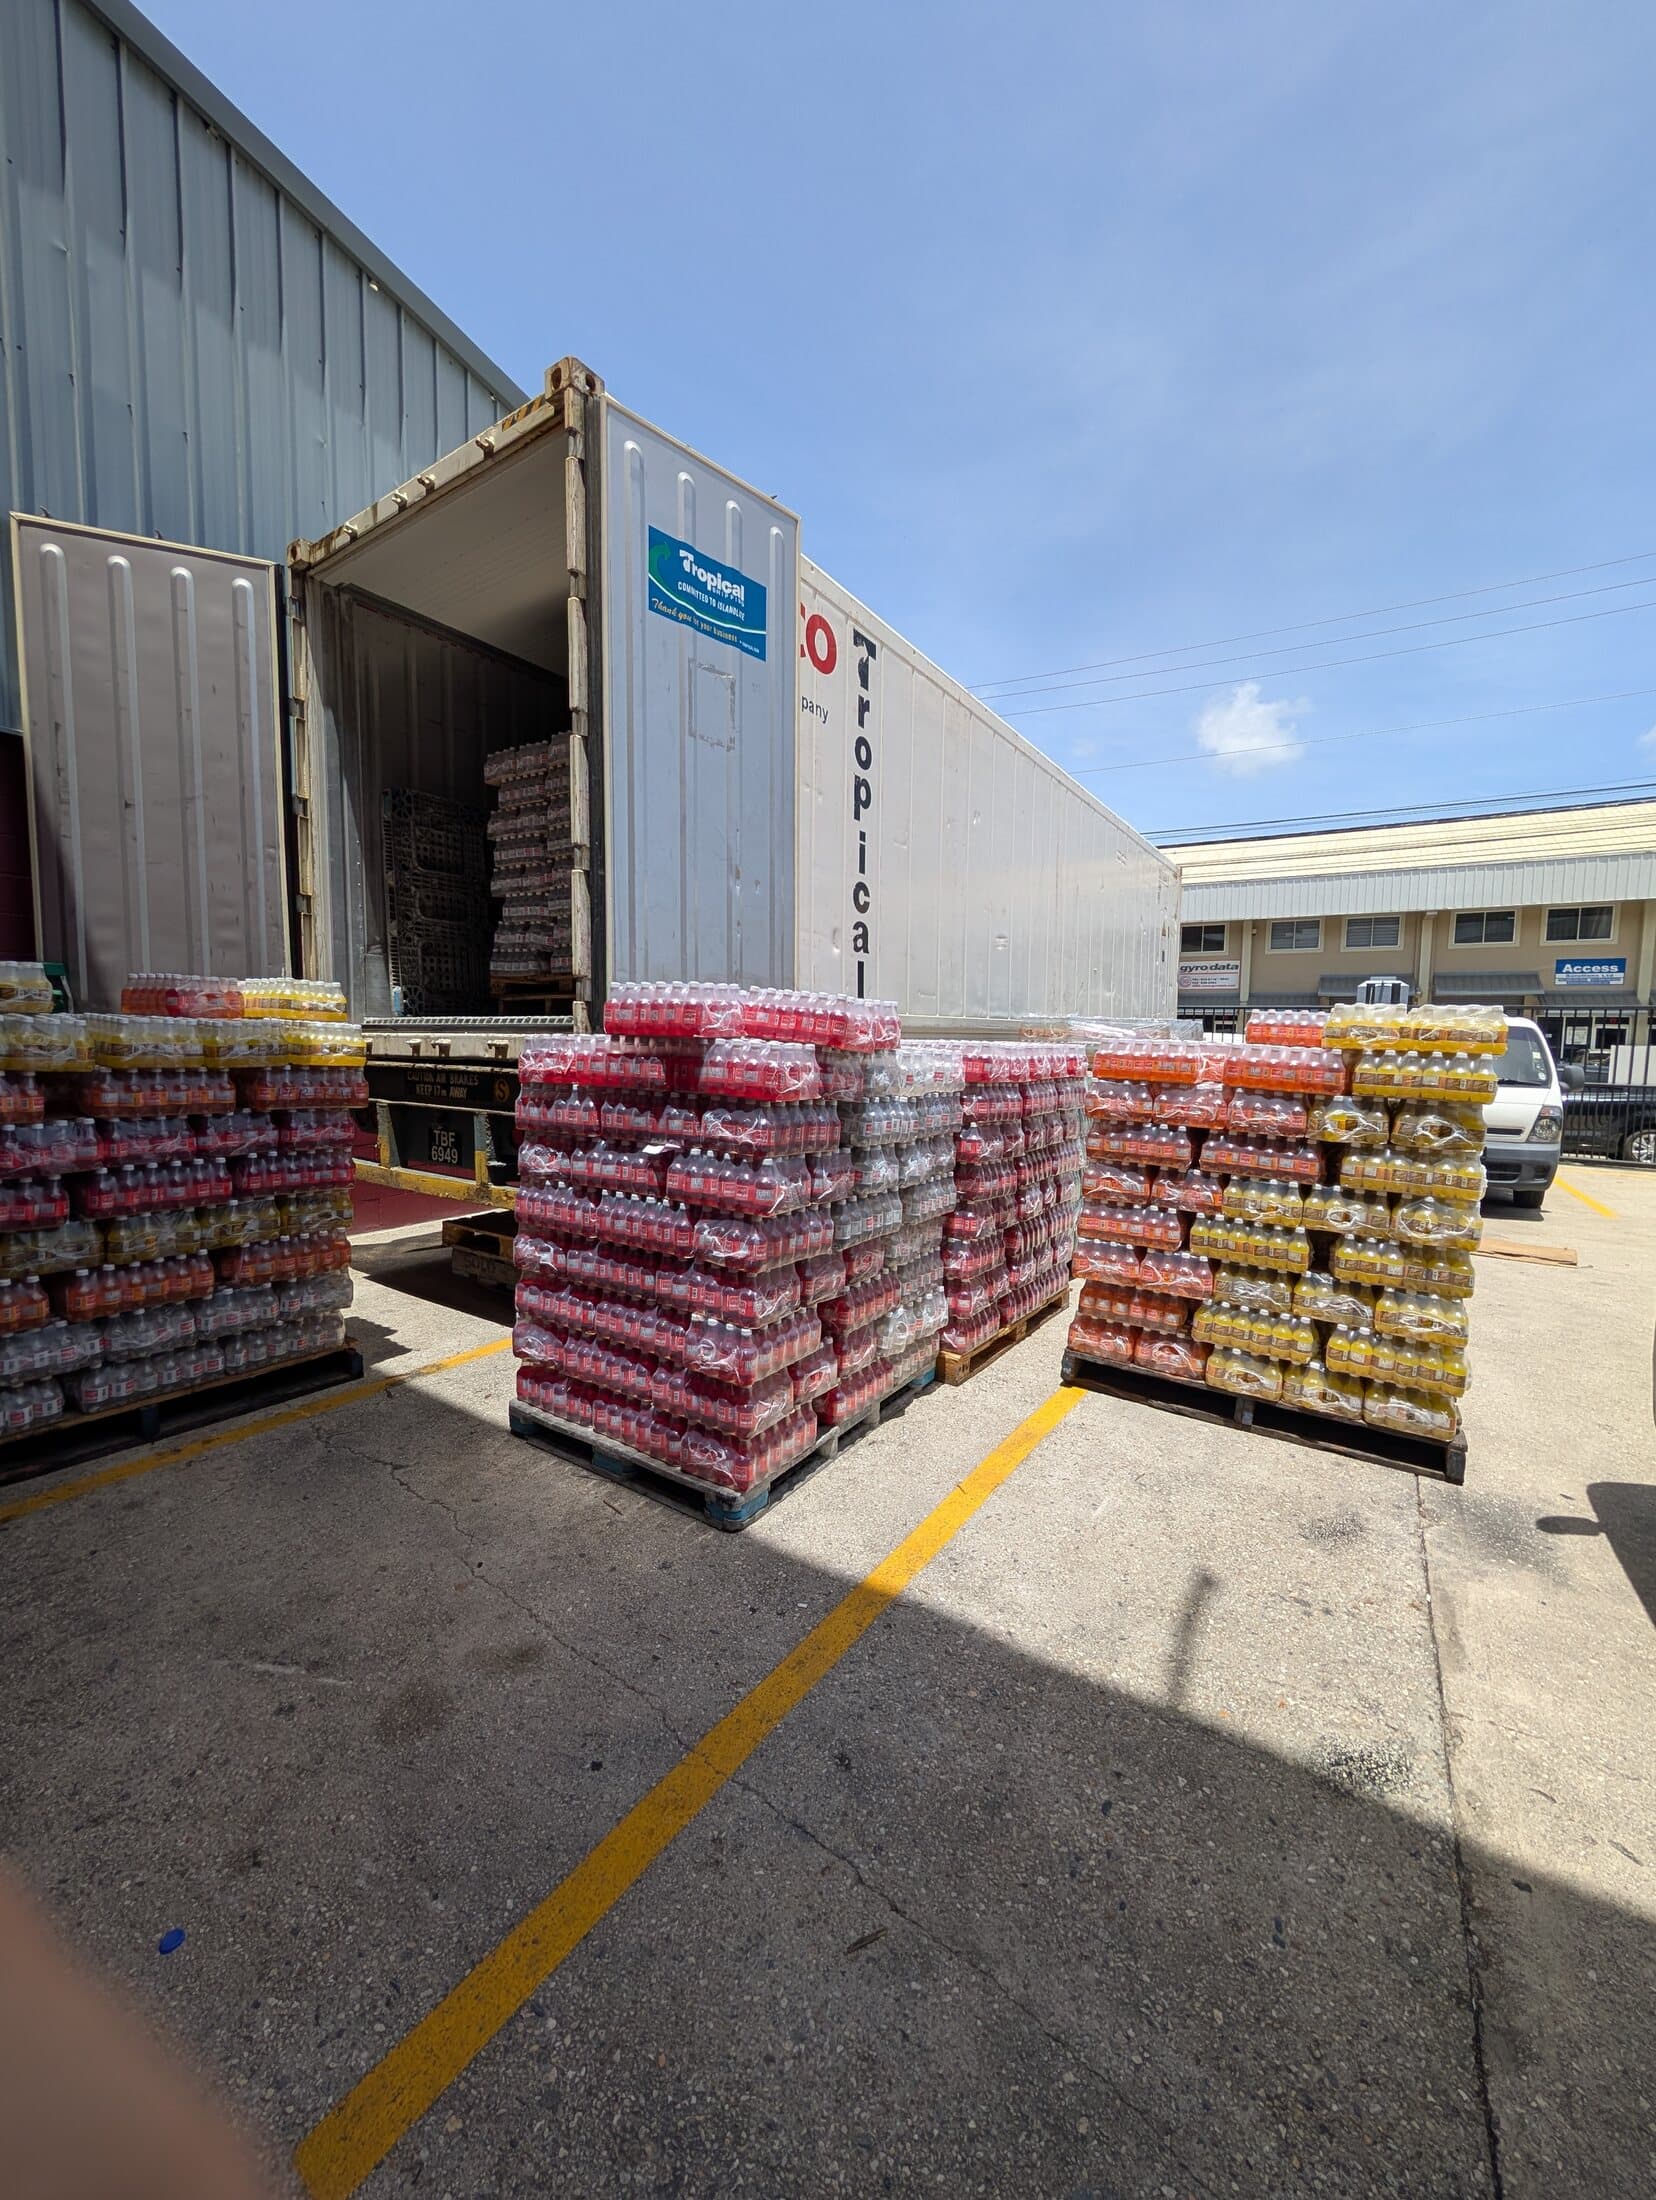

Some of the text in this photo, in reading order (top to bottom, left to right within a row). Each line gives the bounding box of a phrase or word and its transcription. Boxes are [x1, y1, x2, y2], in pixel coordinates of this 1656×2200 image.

[679, 549, 745, 601] Tropical
[651, 598, 677, 616] Thank
[853, 628, 877, 999] Tropical
[1562, 963, 1619, 973] Access
[449, 1072, 480, 1086] BRAKES
[416, 1084, 432, 1096] KEEP
[433, 1130, 456, 1147] TBF
[431, 1145, 458, 1164] 6949
